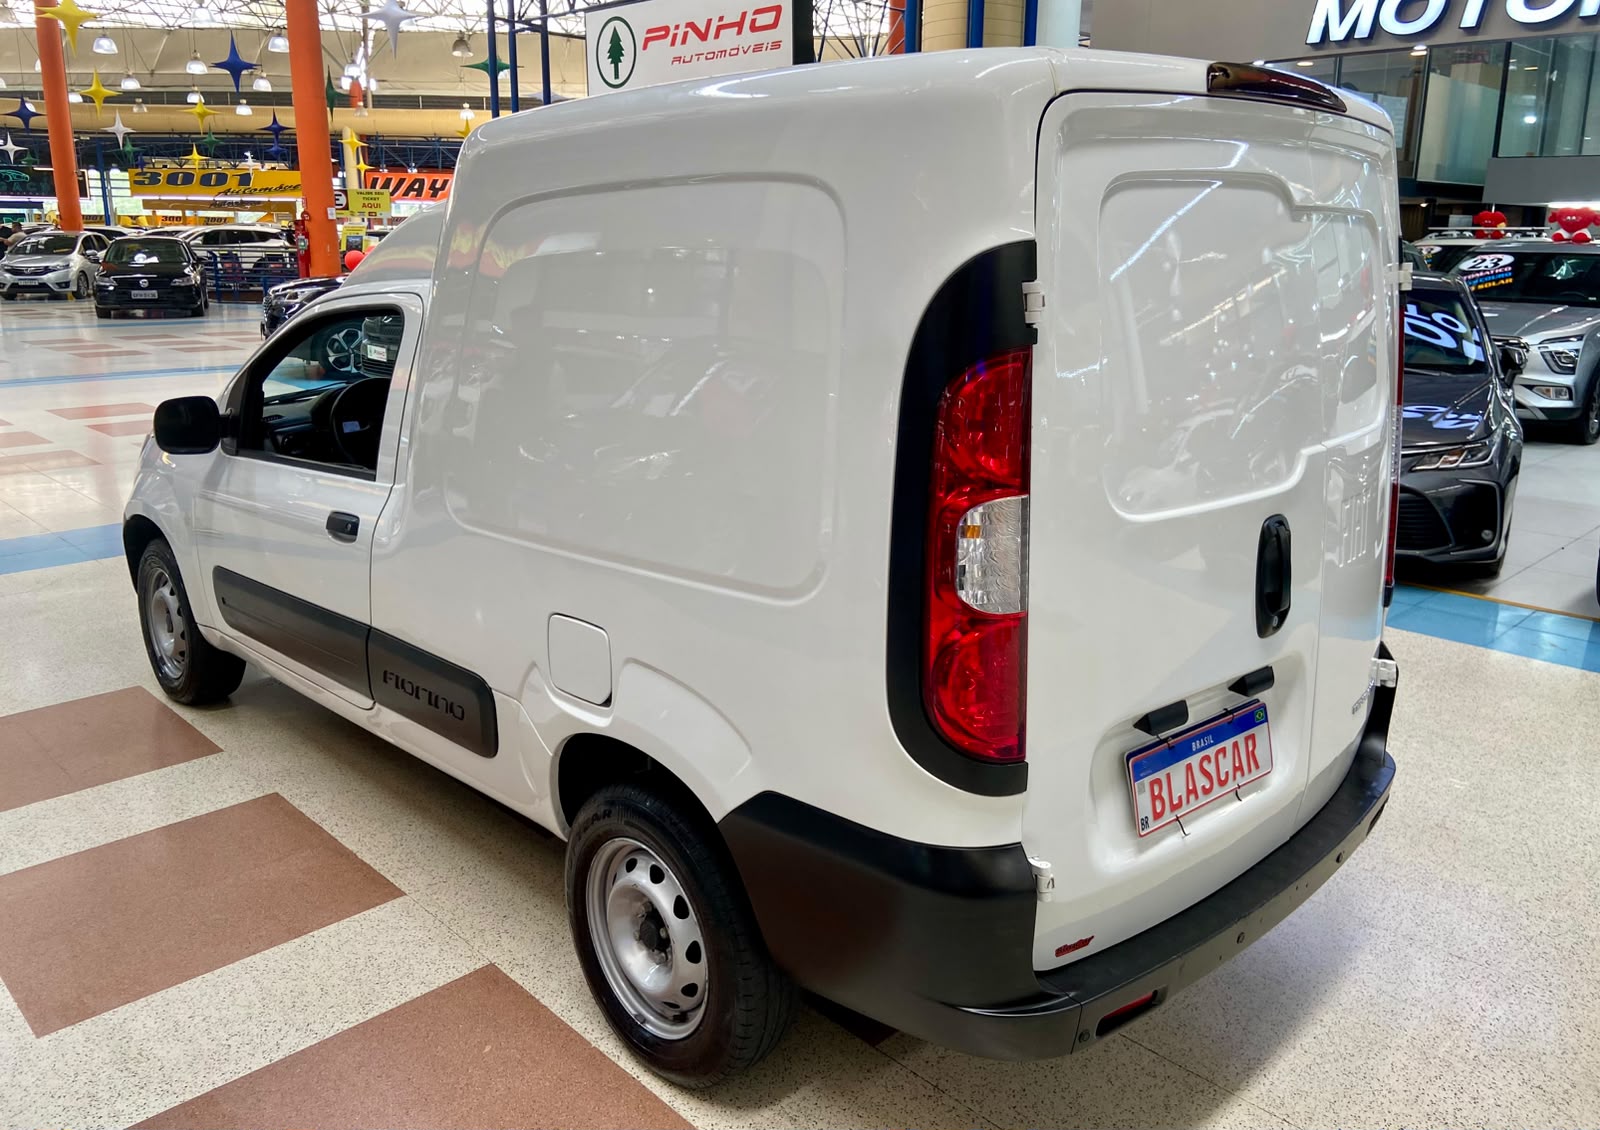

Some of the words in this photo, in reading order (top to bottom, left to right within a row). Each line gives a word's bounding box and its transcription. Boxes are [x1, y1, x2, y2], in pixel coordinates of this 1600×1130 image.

[133, 171, 253, 187] 3001
[370, 177, 450, 198] WAY
[1467, 257, 1504, 270] 23
[1477, 277, 1514, 290] SOLAR
[1191, 733, 1214, 752] BRASIL
[1148, 732, 1260, 823] BLASCAR
[1140, 815, 1150, 832] BR
